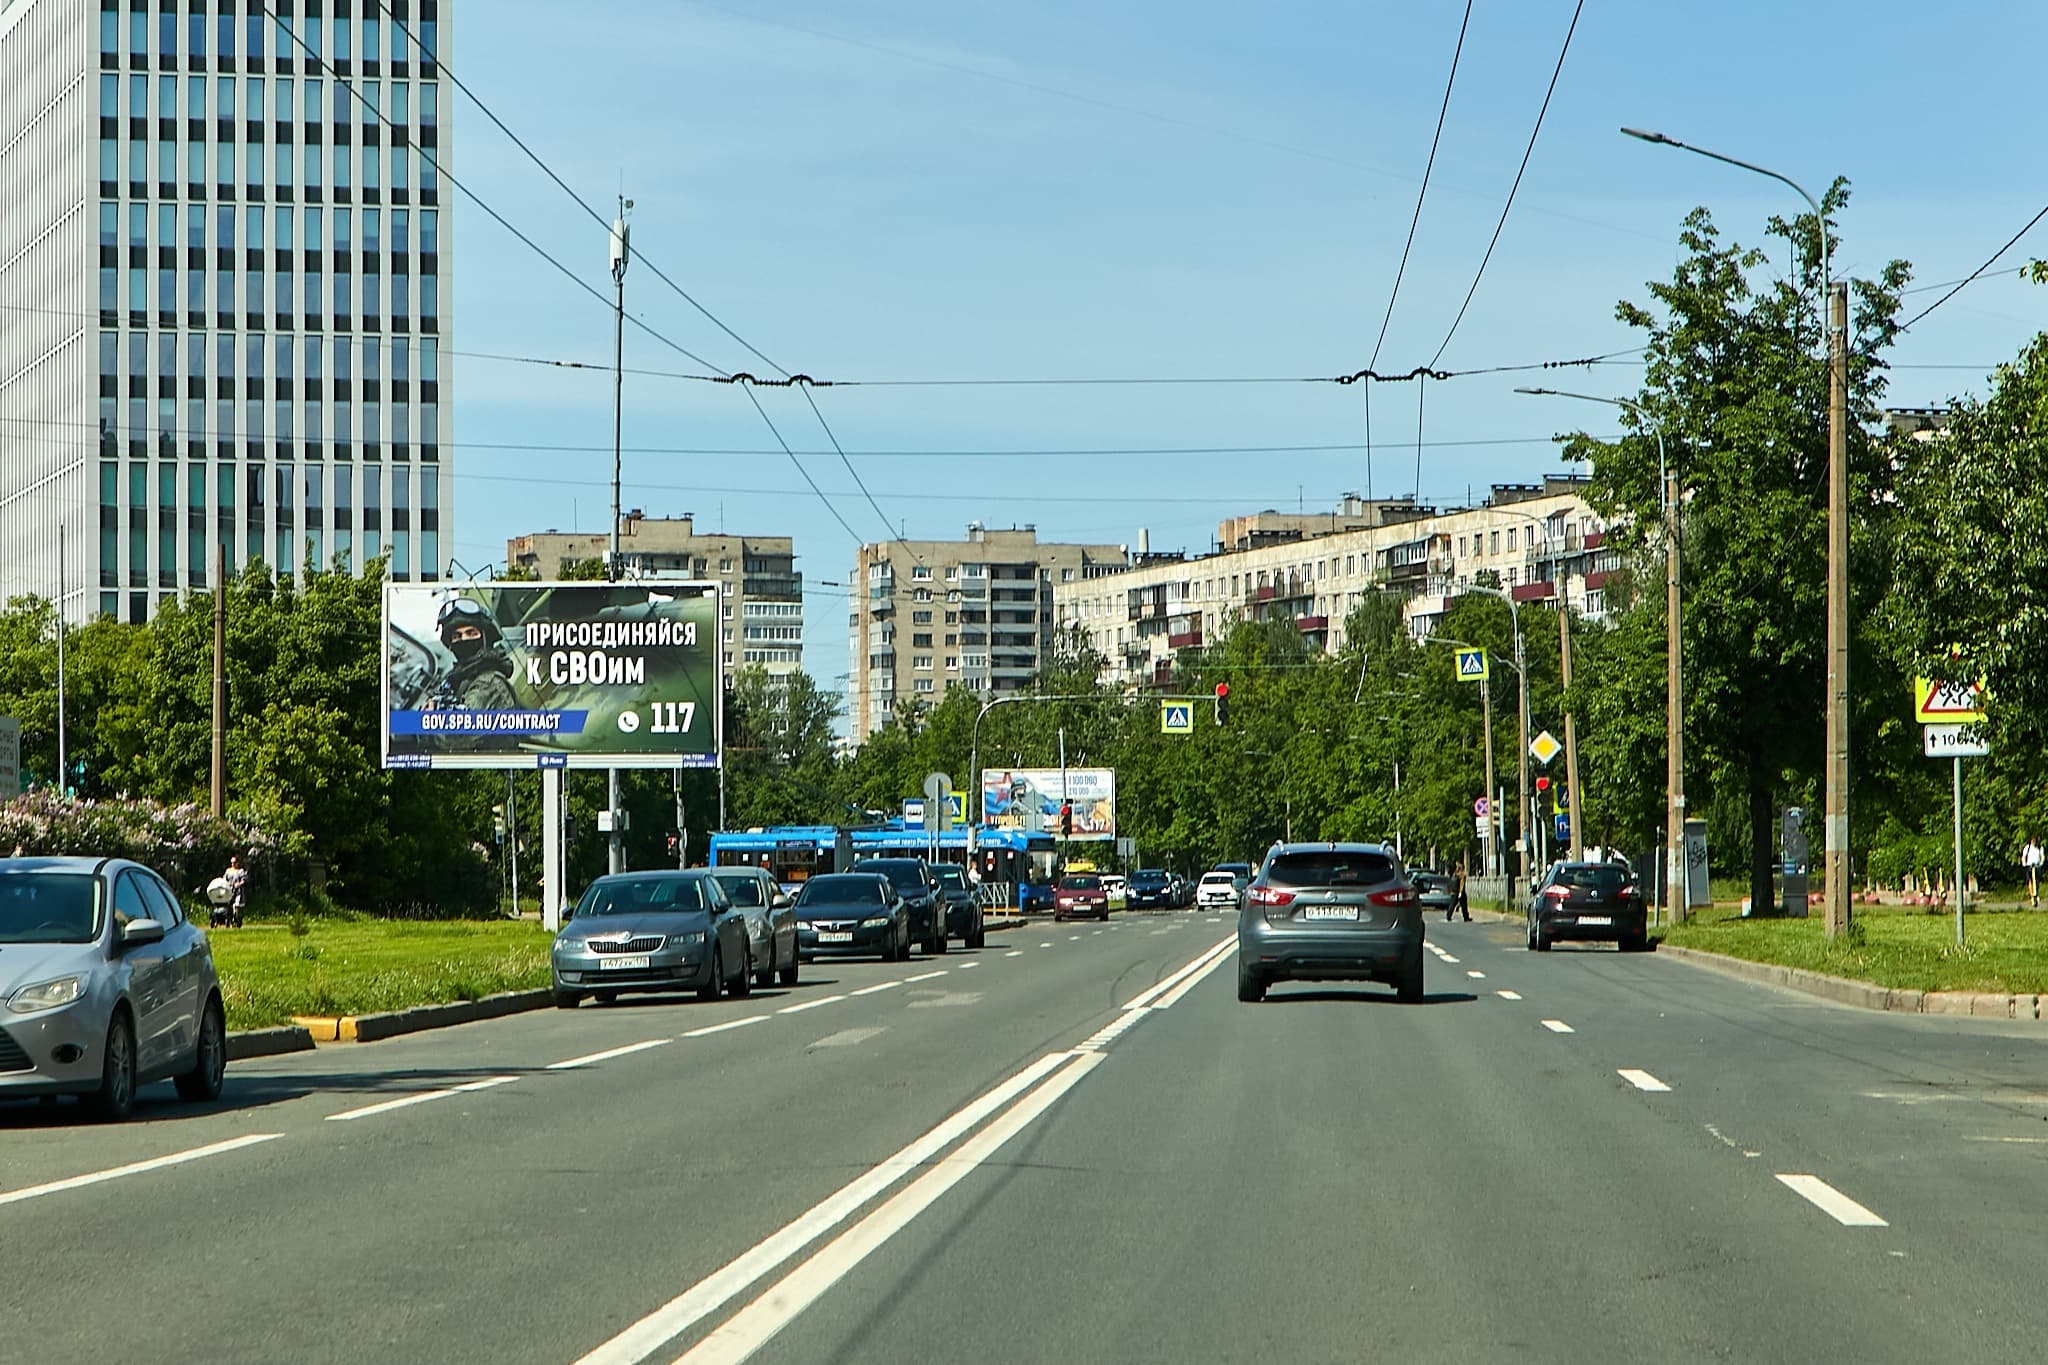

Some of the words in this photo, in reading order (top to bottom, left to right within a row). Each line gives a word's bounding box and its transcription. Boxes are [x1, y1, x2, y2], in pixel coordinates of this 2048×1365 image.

[526, 621, 697, 649] ПРИСОЕДИНЯЙСЯ
[421, 713, 561, 731] GOV.SPB.RU/CONTRACT
[650, 702, 696, 734] 117
